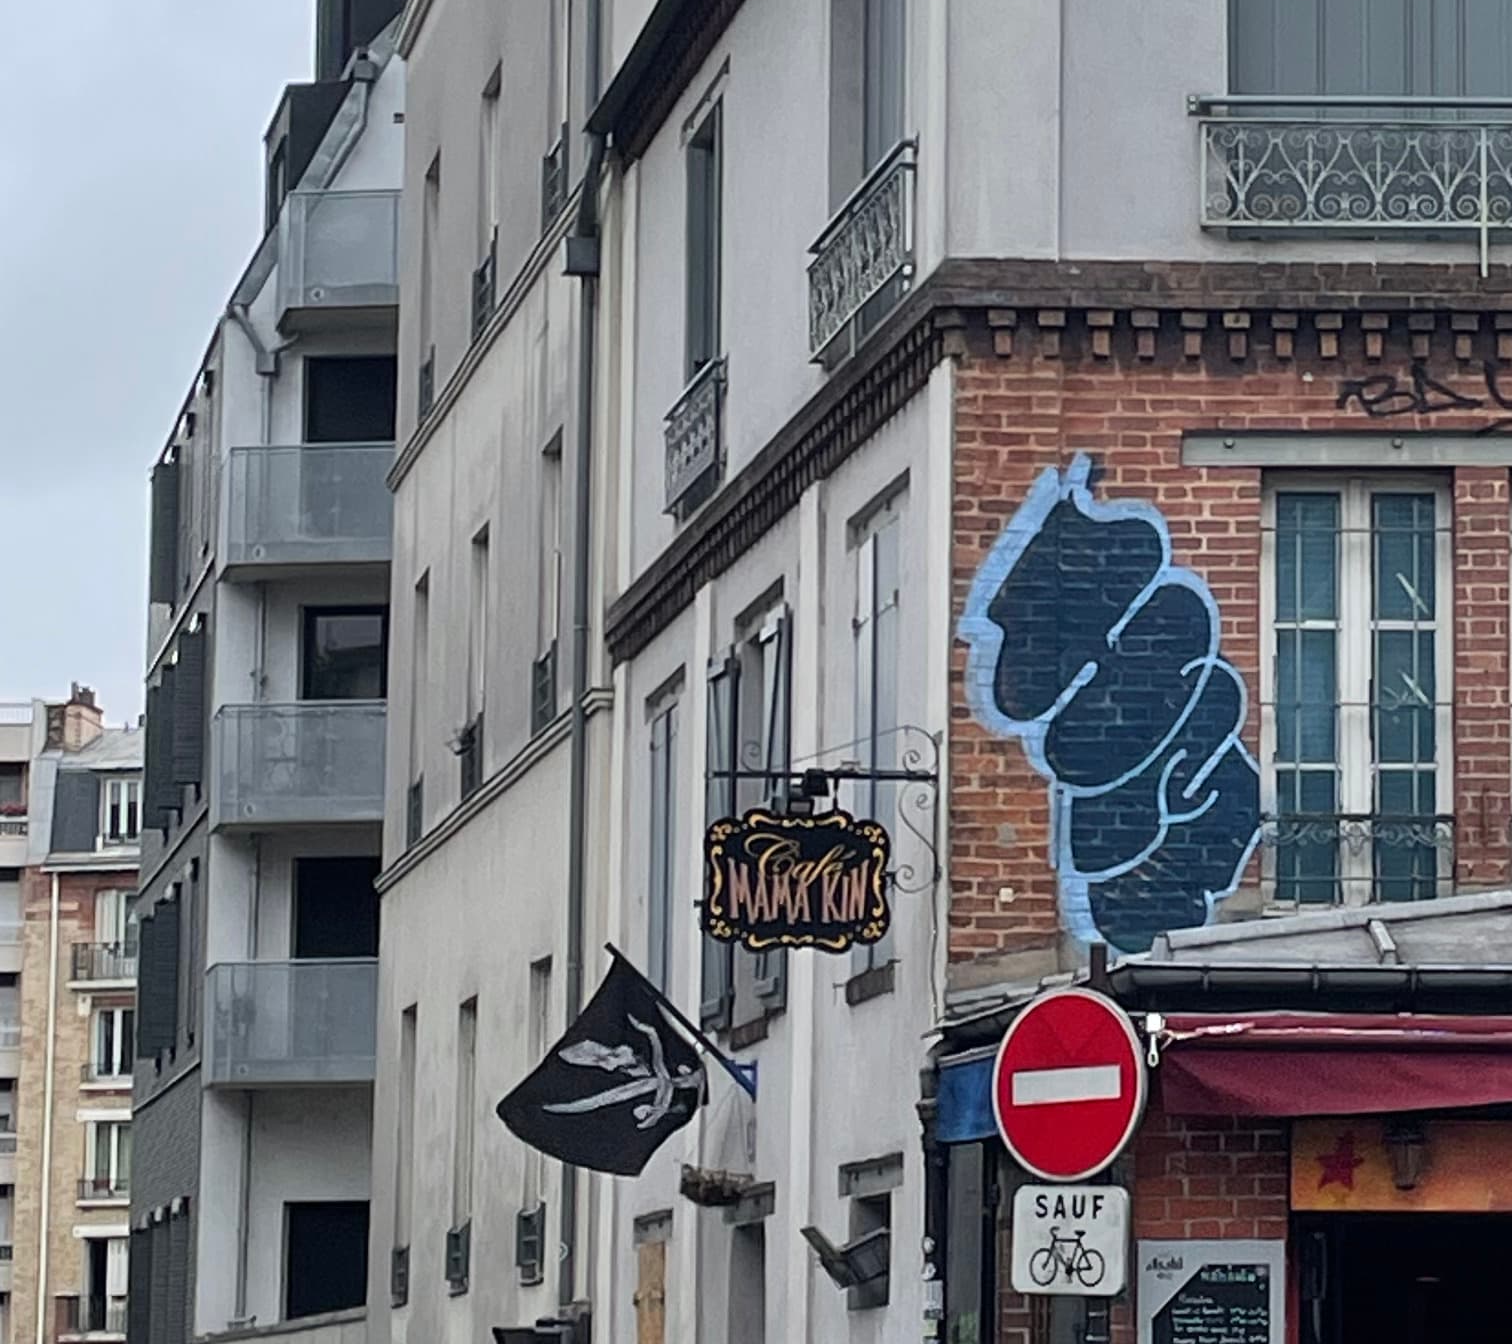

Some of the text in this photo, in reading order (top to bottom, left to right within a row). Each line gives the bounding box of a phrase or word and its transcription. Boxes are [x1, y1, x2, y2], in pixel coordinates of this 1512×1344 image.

[745, 833, 856, 885] Café
[728, 857, 869, 925] MAMA KIN
[1035, 1194, 1105, 1219] SAUF
